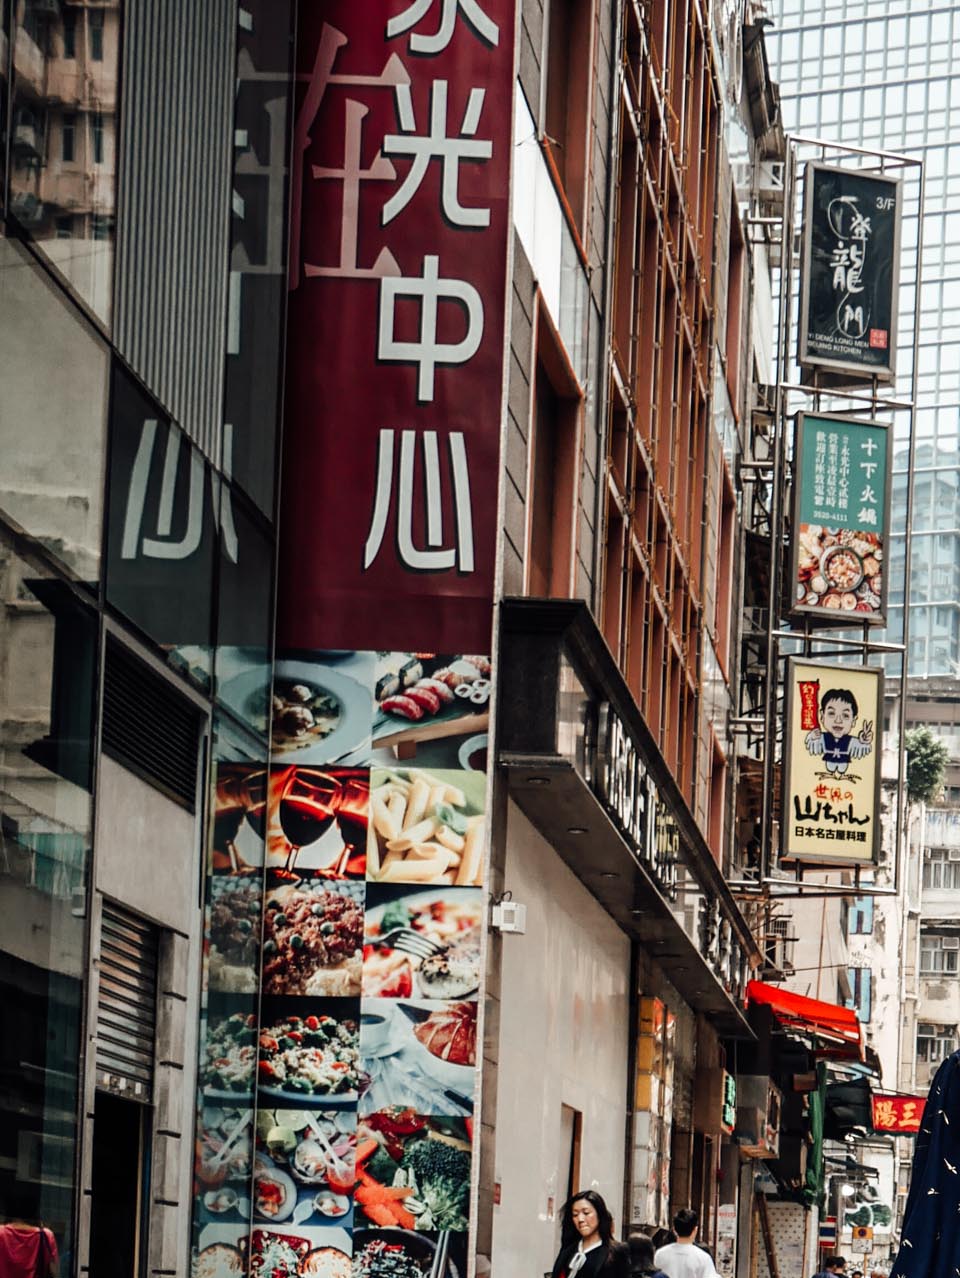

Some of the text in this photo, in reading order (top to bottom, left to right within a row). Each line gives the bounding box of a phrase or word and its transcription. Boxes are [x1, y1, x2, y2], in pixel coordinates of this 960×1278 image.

[876, 196, 895, 211] 3/F
[794, 794, 870, 825] 山ちゃん
[794, 826, 867, 842] 日本名古屋料理
